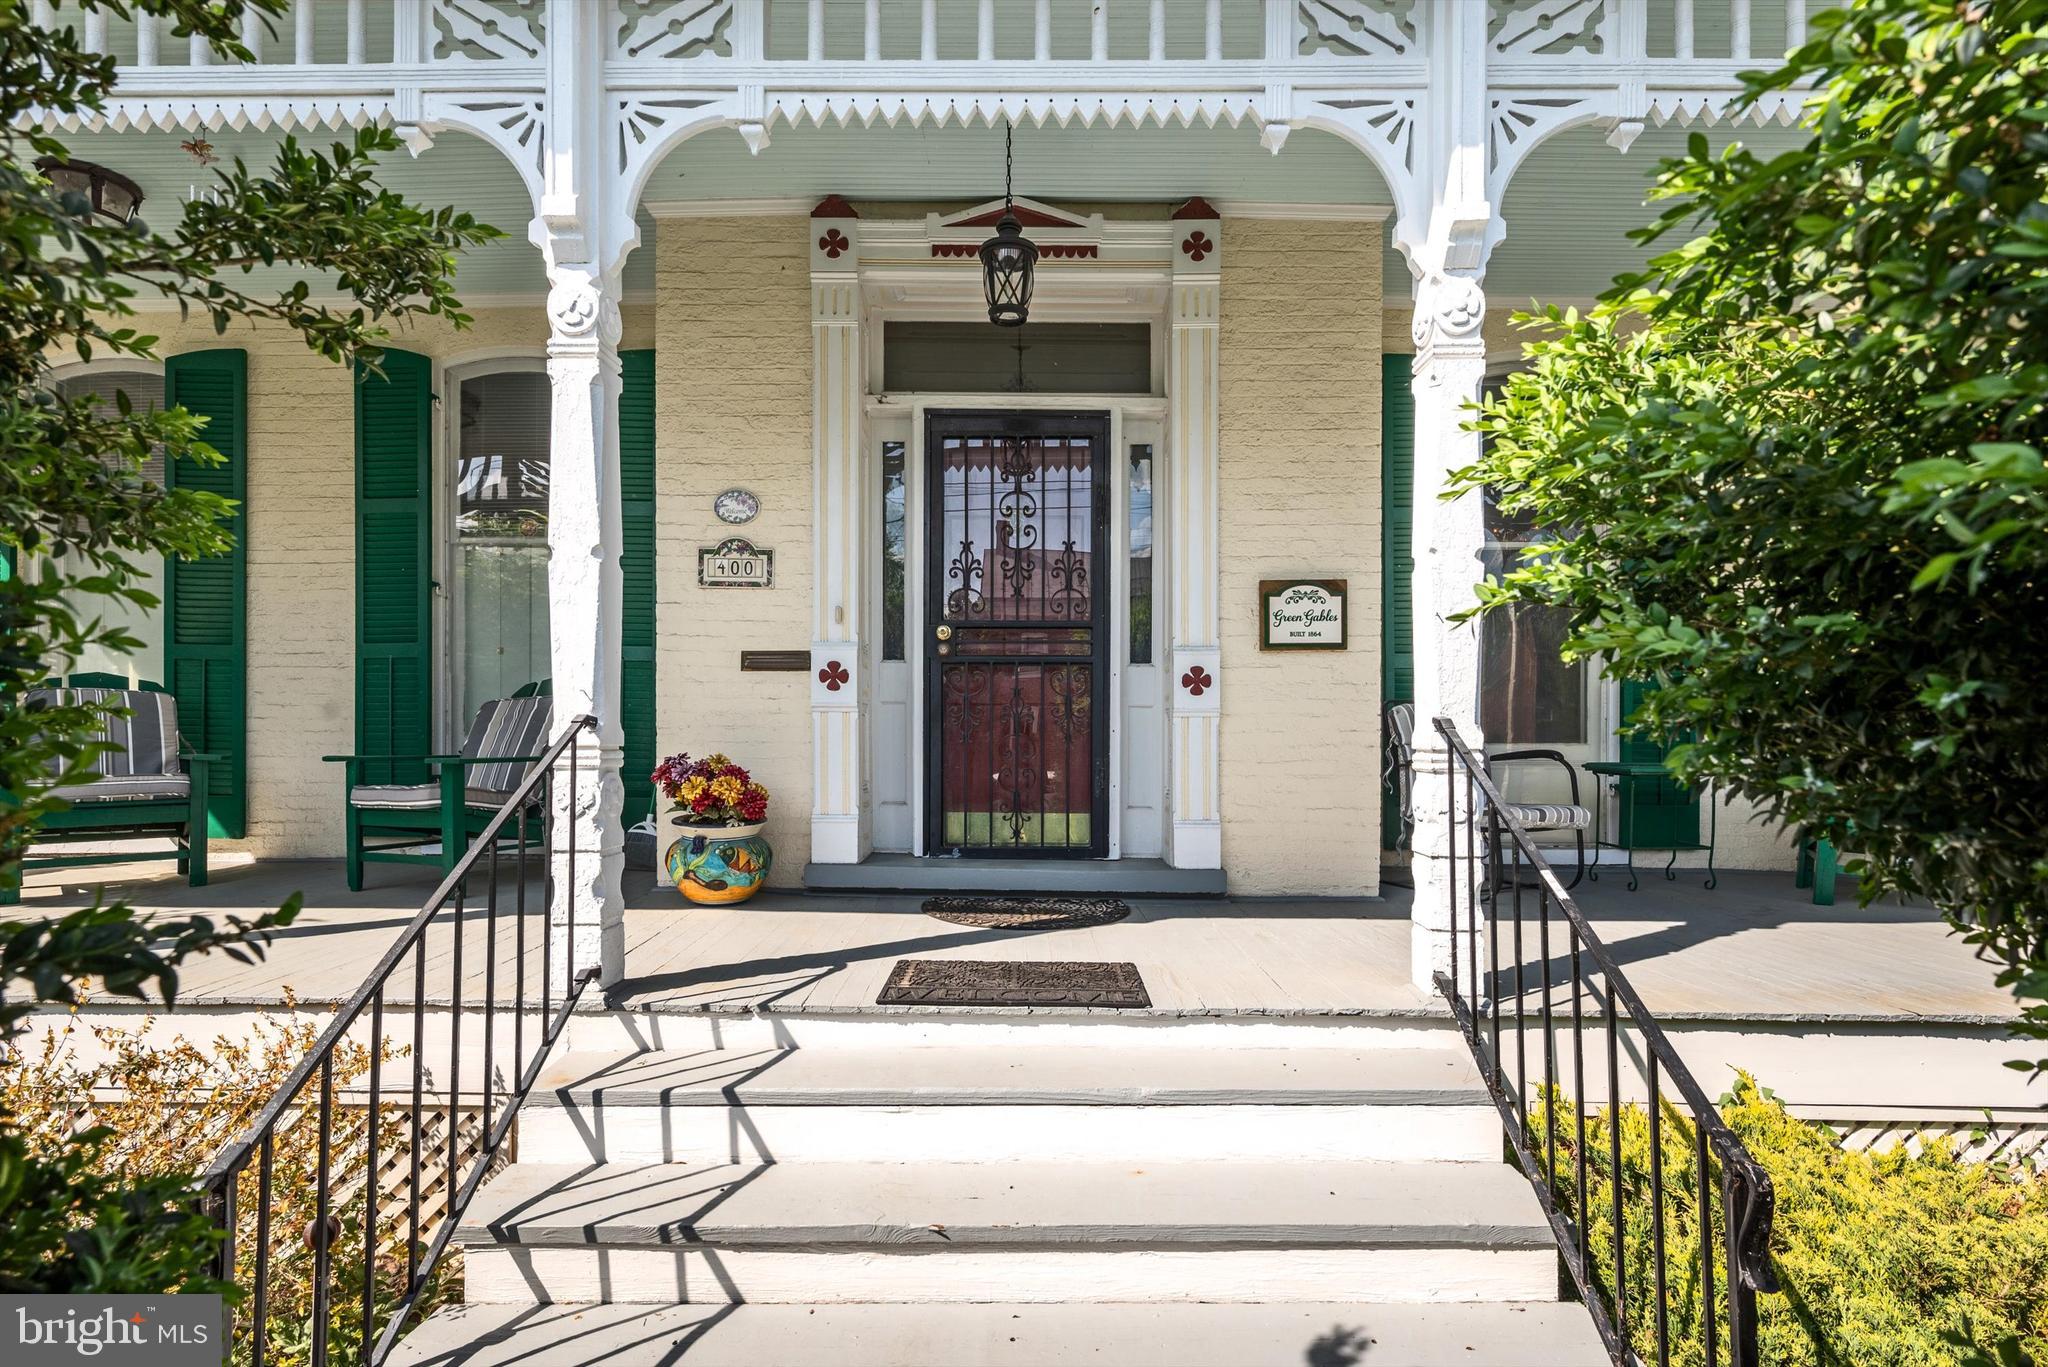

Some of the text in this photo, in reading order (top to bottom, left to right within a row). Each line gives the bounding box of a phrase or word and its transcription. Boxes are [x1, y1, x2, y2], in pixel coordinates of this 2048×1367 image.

[717, 560, 753, 575] 400
[1272, 609, 1338, 627] Green Gables
[883, 987, 1142, 1003] WELCOME
